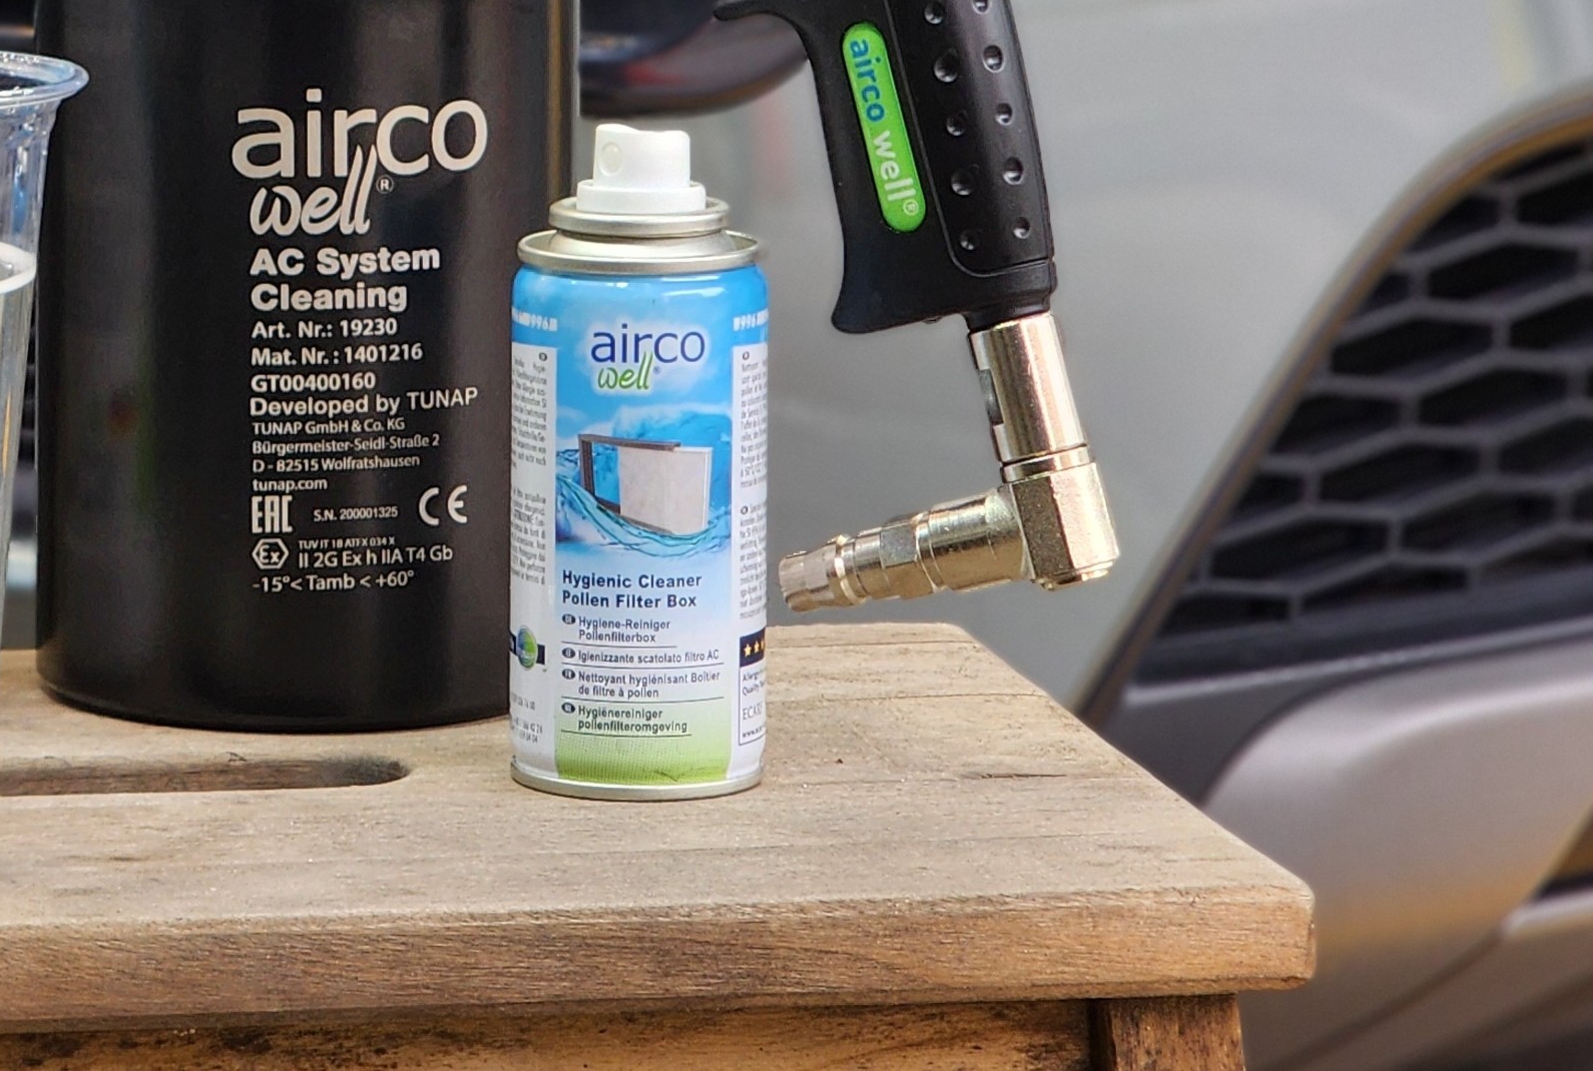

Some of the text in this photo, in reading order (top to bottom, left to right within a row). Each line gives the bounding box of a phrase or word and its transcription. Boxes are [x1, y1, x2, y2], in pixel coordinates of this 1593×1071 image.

[849, 39, 917, 201] airco well
[231, 88, 488, 179] airco
[250, 144, 378, 235] well
[250, 247, 441, 280] AC System
[250, 282, 408, 313] Cleaning
[251, 317, 398, 338] Art. Nr.: 19230
[590, 323, 705, 364] airco
[251, 347, 297, 366] Mat.
[344, 343, 423, 364] 1401216
[597, 351, 654, 390] well
[251, 372, 376, 392] GT00400160
[250, 387, 478, 419] Developed by TUNAP
[252, 417, 405, 435] TUNAP GmbH & Co. KG
[252, 434, 440, 456] Bürgermeister-Seidl-Straße 2
[252, 459, 265, 473] D
[276, 457, 319, 472] 82515
[321, 455, 420, 471] Wolfratshausen
[252, 478, 328, 493] tunap.com
[251, 495, 293, 534] EAC
[313, 508, 337, 522] S.N.
[418, 485, 468, 526] CE
[313, 551, 338, 568] 2G
[342, 549, 362, 566] Ex
[366, 548, 377, 565] h
[381, 548, 403, 564] IIA
[406, 547, 426, 563] T4
[429, 545, 453, 561] Gb
[306, 573, 355, 590] Tamb
[374, 570, 414, 587] +60°
[562, 570, 702, 589] Hygienic Cleaner
[562, 590, 697, 609] Pollen Filter Box
[578, 615, 670, 632] Hygiene-Reiniger
[578, 630, 656, 642] Pollenfilterbox
[578, 650, 635, 663] Igienizzante
[637, 653, 682, 663] scatolato
[684, 652, 704, 662] filtro
[707, 649, 719, 660] AC
[578, 671, 625, 687] Nettoyant
[629, 673, 688, 688] hygiénisant
[691, 670, 720, 683] Boîtier
[578, 685, 590, 695] de
[592, 685, 615, 697] filtre
[628, 687, 659, 699] pollen
[578, 720, 688, 734] pollenfilteromgeving
